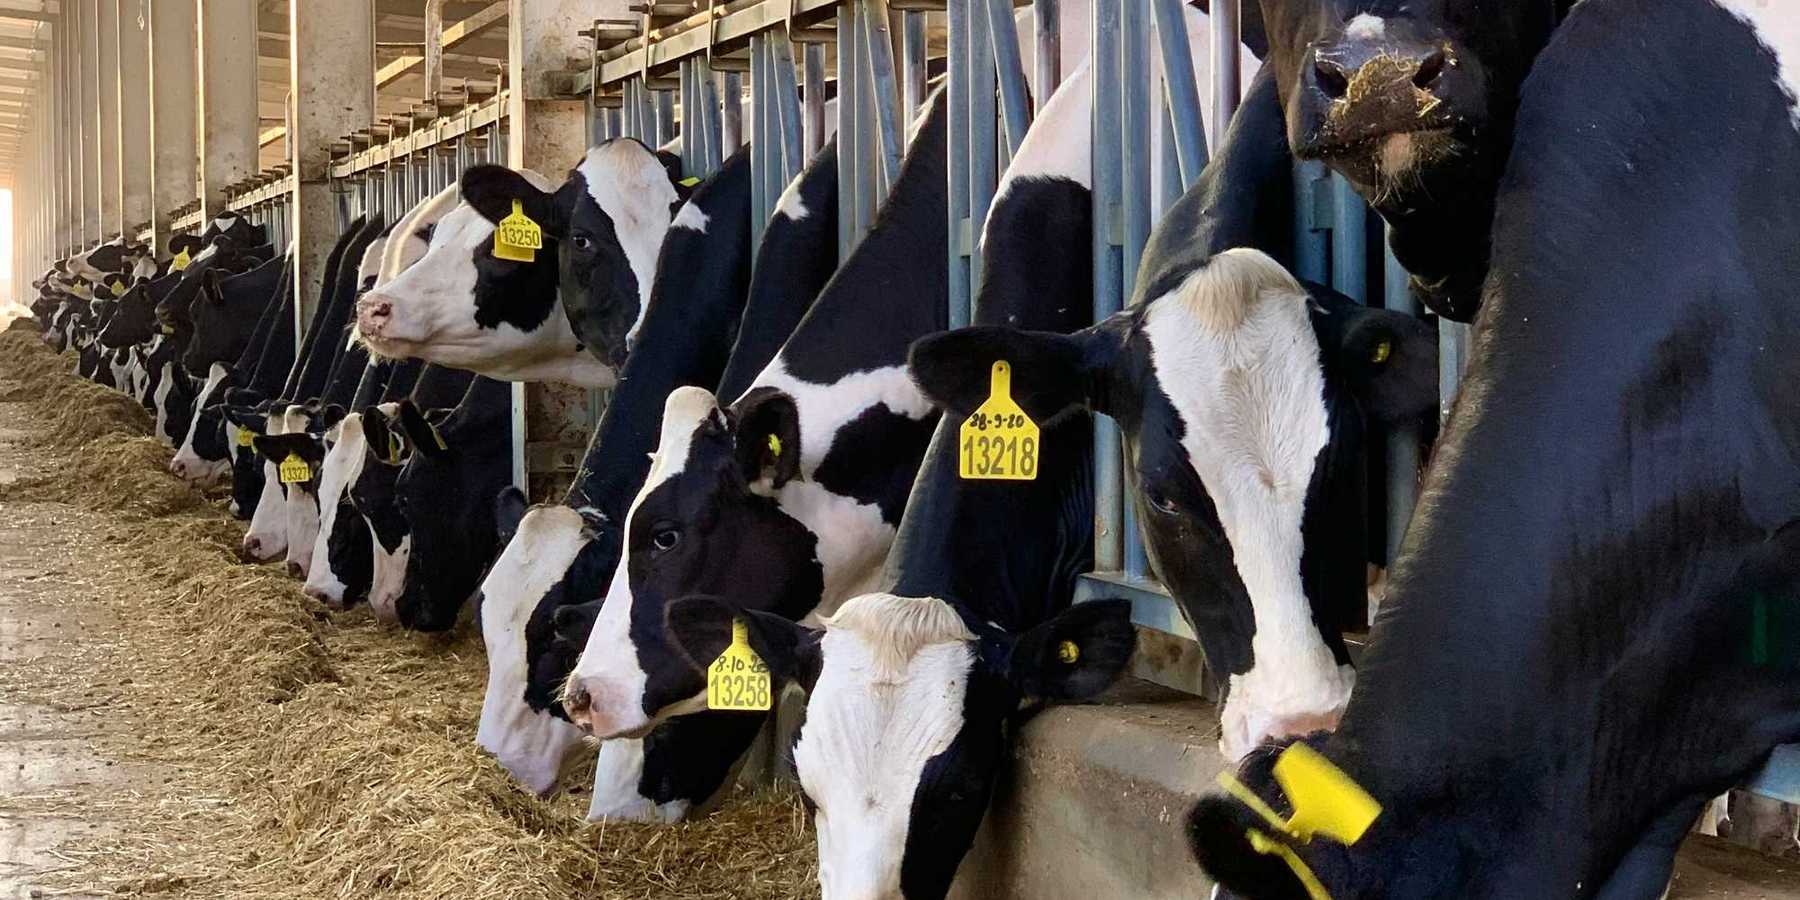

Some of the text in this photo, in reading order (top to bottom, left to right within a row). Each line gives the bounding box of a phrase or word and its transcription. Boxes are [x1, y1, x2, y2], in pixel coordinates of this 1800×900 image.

[501, 227, 540, 246] 13250
[964, 435, 1035, 476] 13218
[710, 674, 768, 707] 13258
